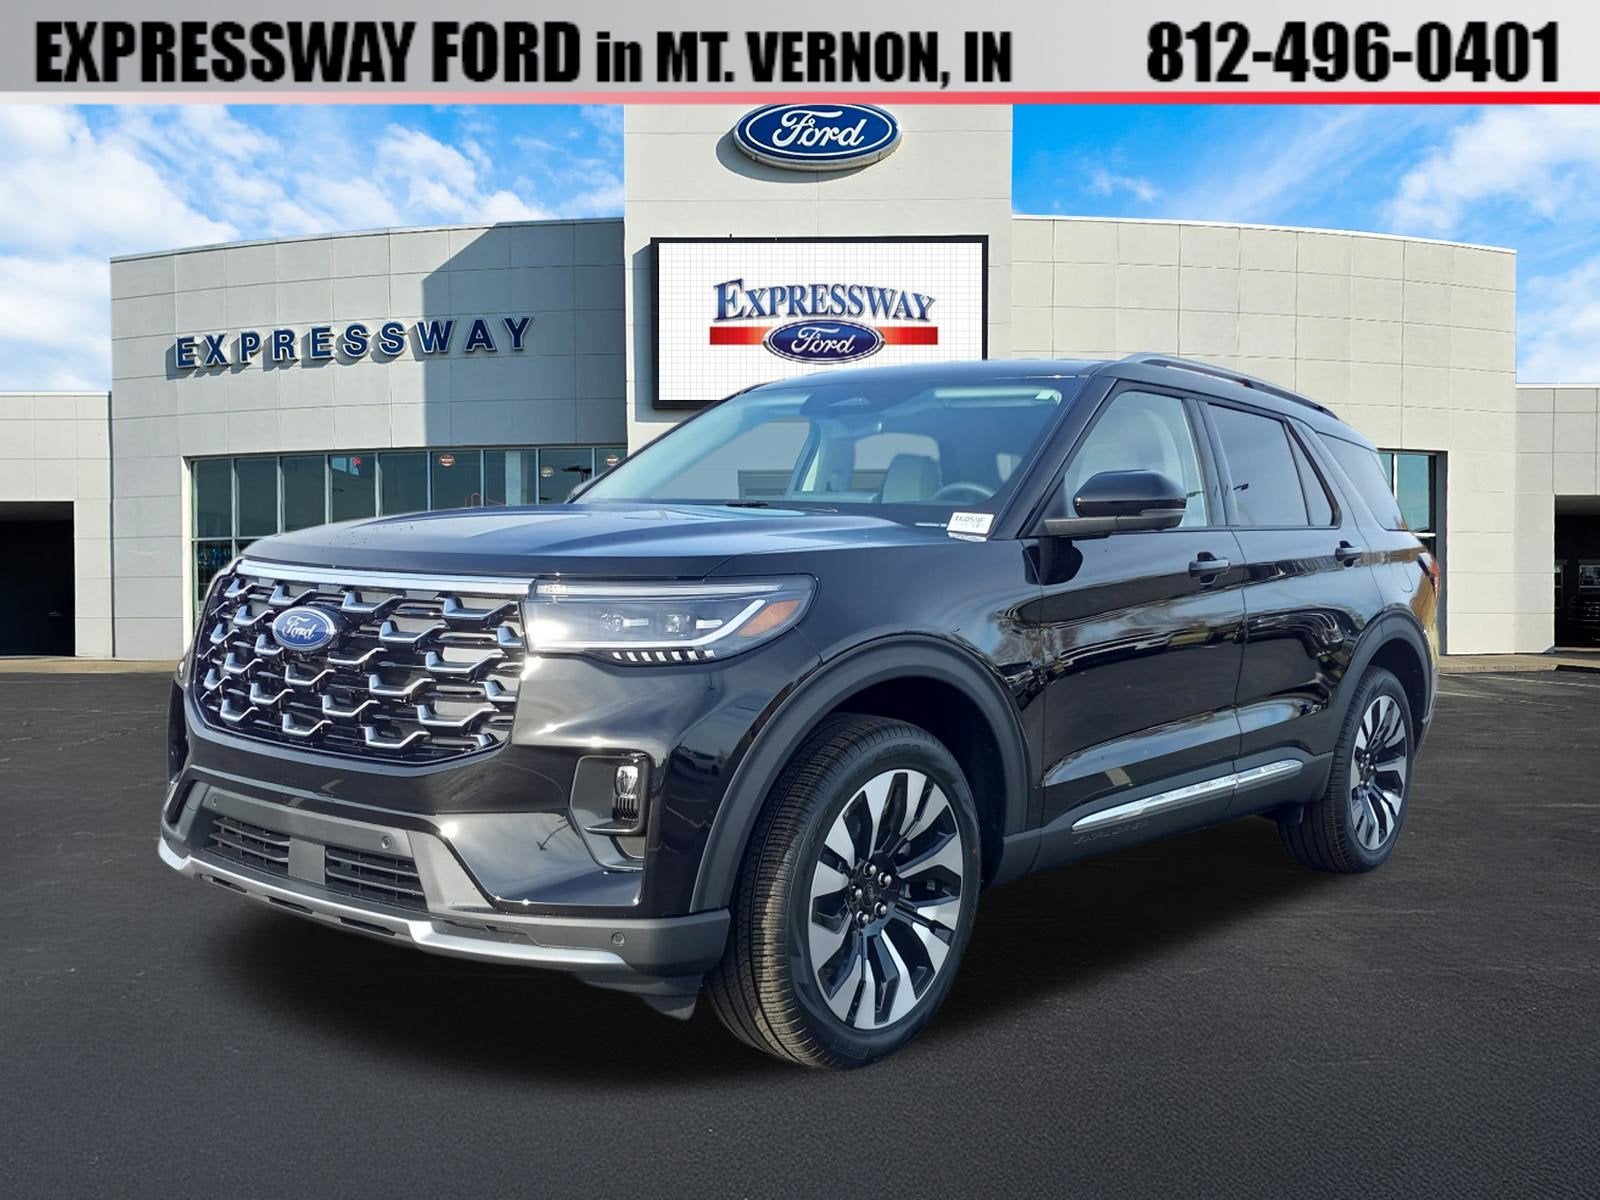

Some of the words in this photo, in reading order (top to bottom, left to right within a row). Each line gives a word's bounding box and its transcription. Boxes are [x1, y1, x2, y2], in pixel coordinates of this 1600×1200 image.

[772, 109, 868, 148] Ford
[713, 278, 936, 322] EXPRESSWAY
[174, 315, 534, 370] EXPRESSWAY
[791, 326, 857, 354] Ford
[281, 615, 317, 640] Ford
